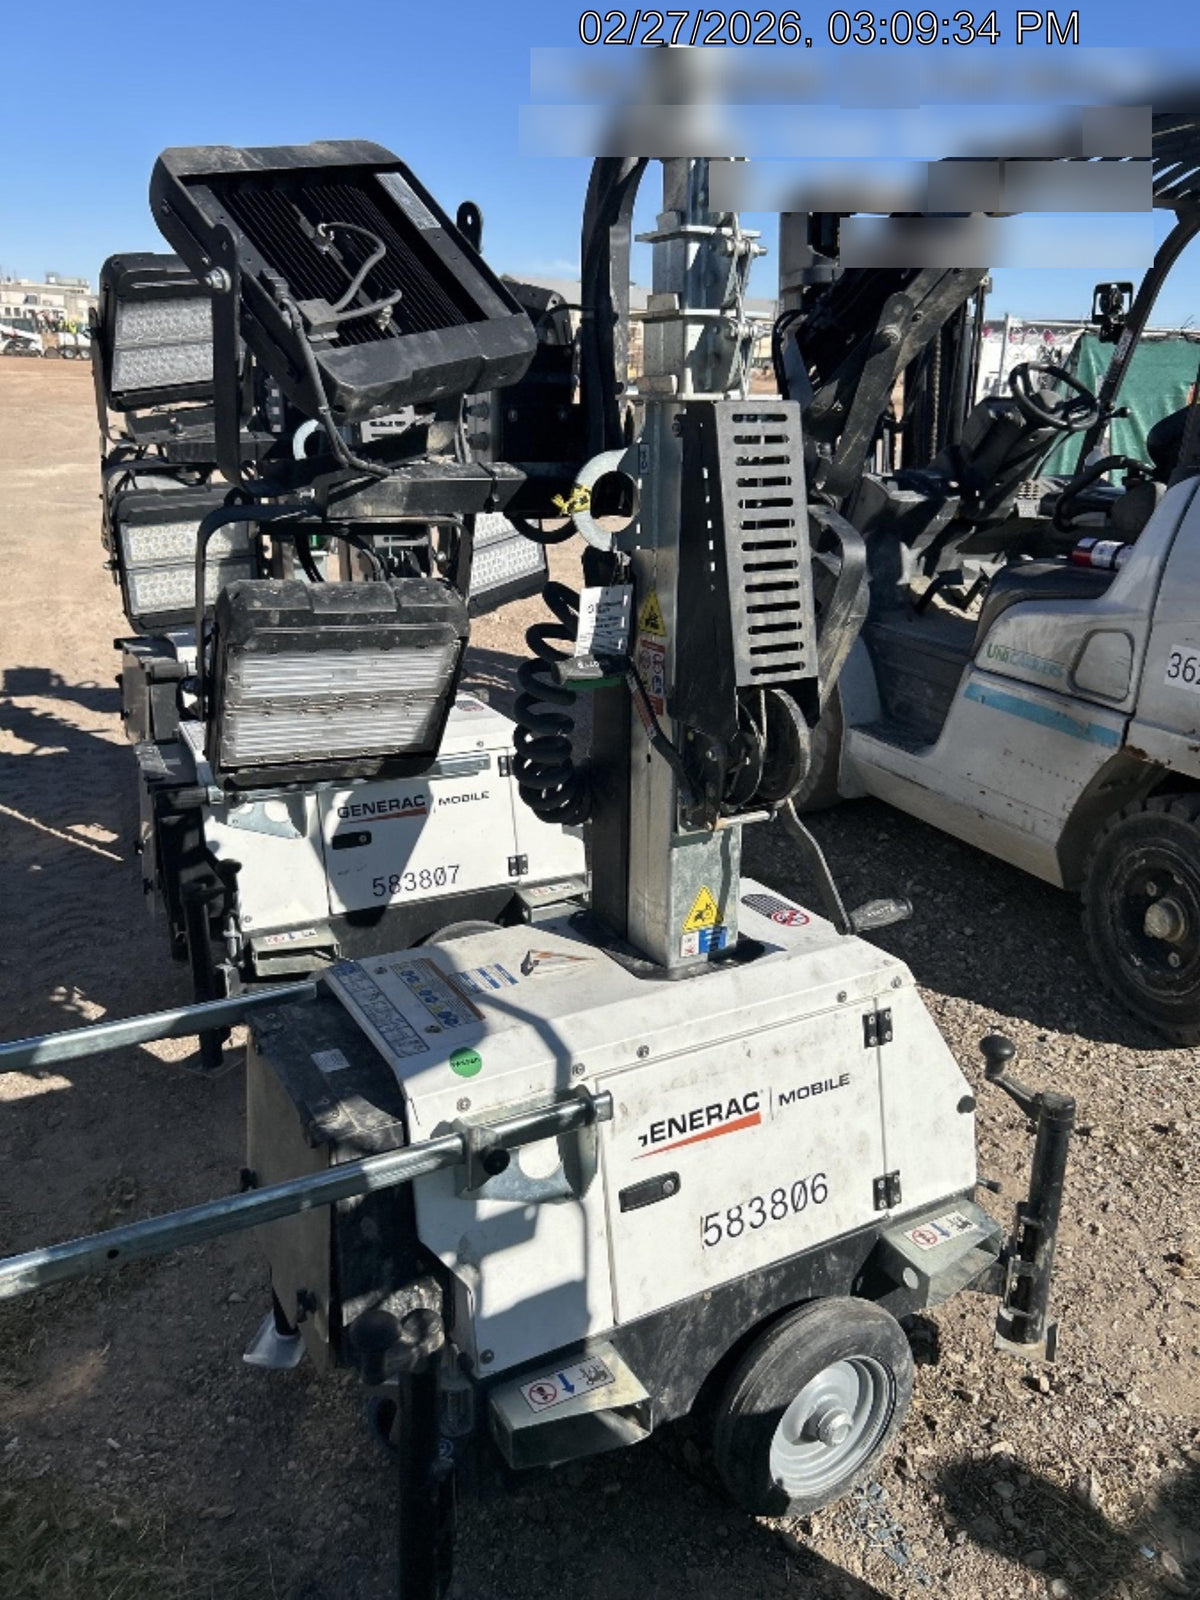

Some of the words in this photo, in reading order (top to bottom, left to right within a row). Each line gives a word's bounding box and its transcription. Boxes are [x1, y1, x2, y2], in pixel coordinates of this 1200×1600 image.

[337, 794, 426, 819] GENERAC
[438, 790, 490, 806] MOBILE
[372, 865, 460, 897] 583807
[778, 1073, 851, 1107] MOBILE
[702, 1172, 829, 1248] 583806
